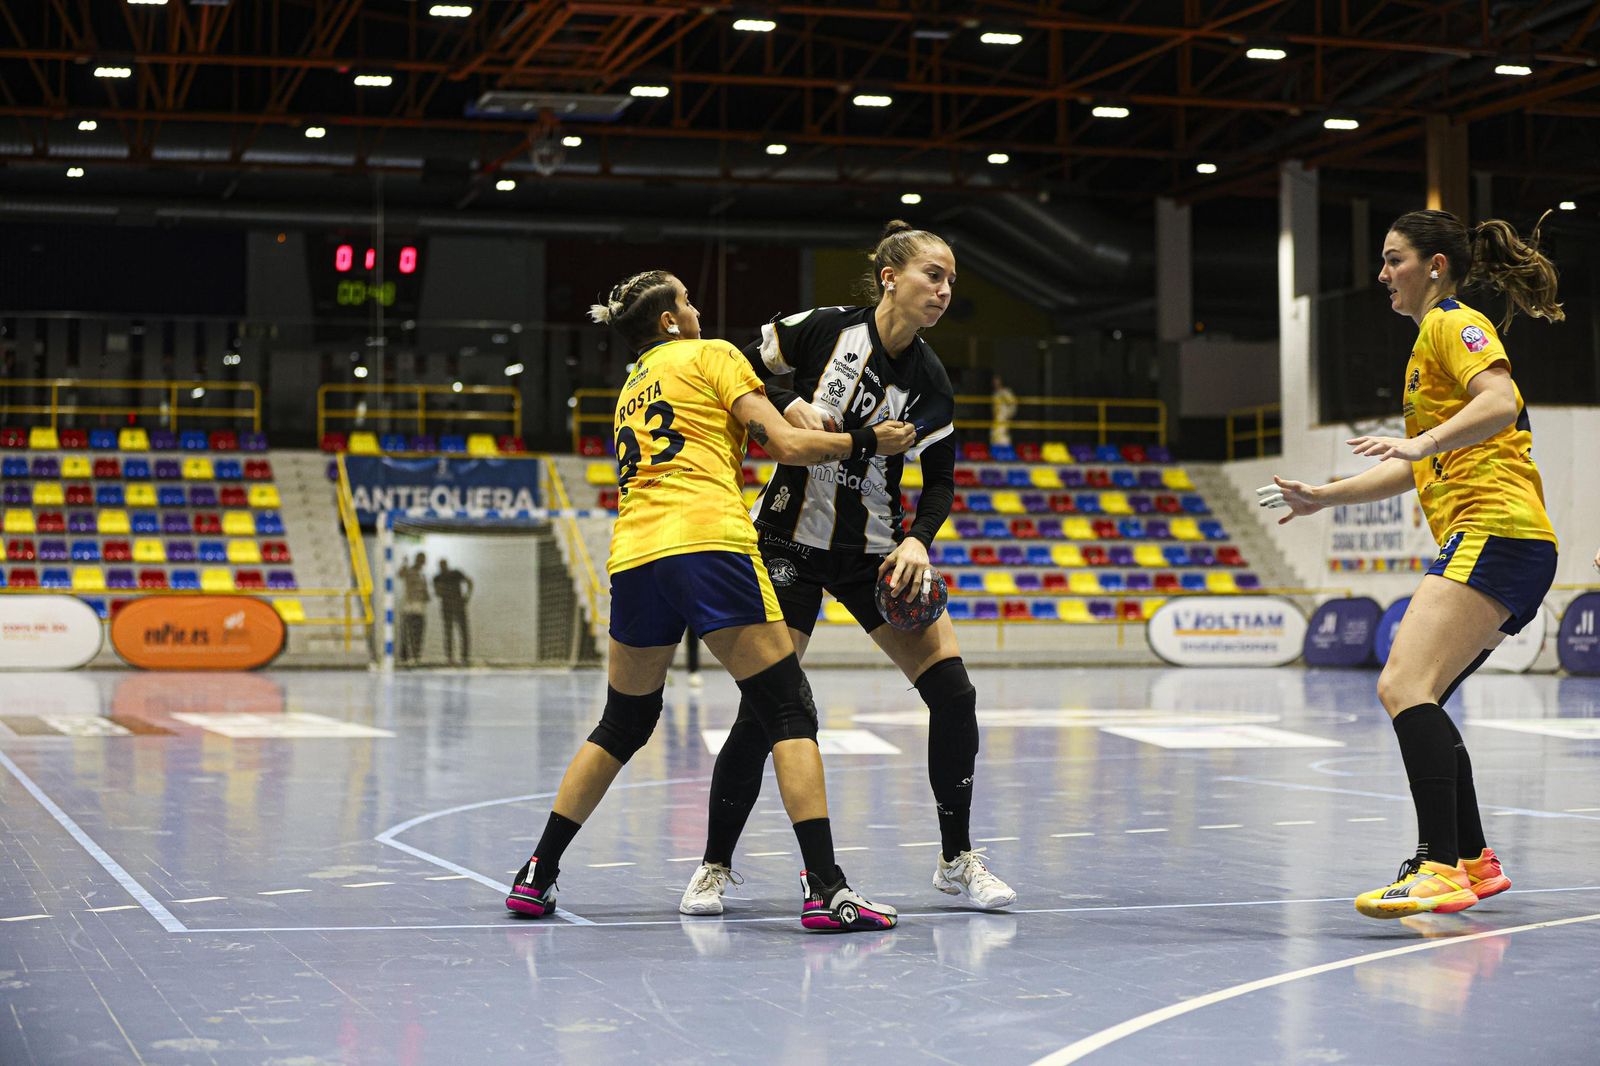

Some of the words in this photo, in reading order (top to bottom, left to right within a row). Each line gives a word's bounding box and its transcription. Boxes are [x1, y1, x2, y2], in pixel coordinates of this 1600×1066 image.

[336, 244, 353, 272] 0
[399, 245, 418, 274] 0
[850, 381, 877, 418] 19
[353, 486, 537, 517] ANTEQUERA
